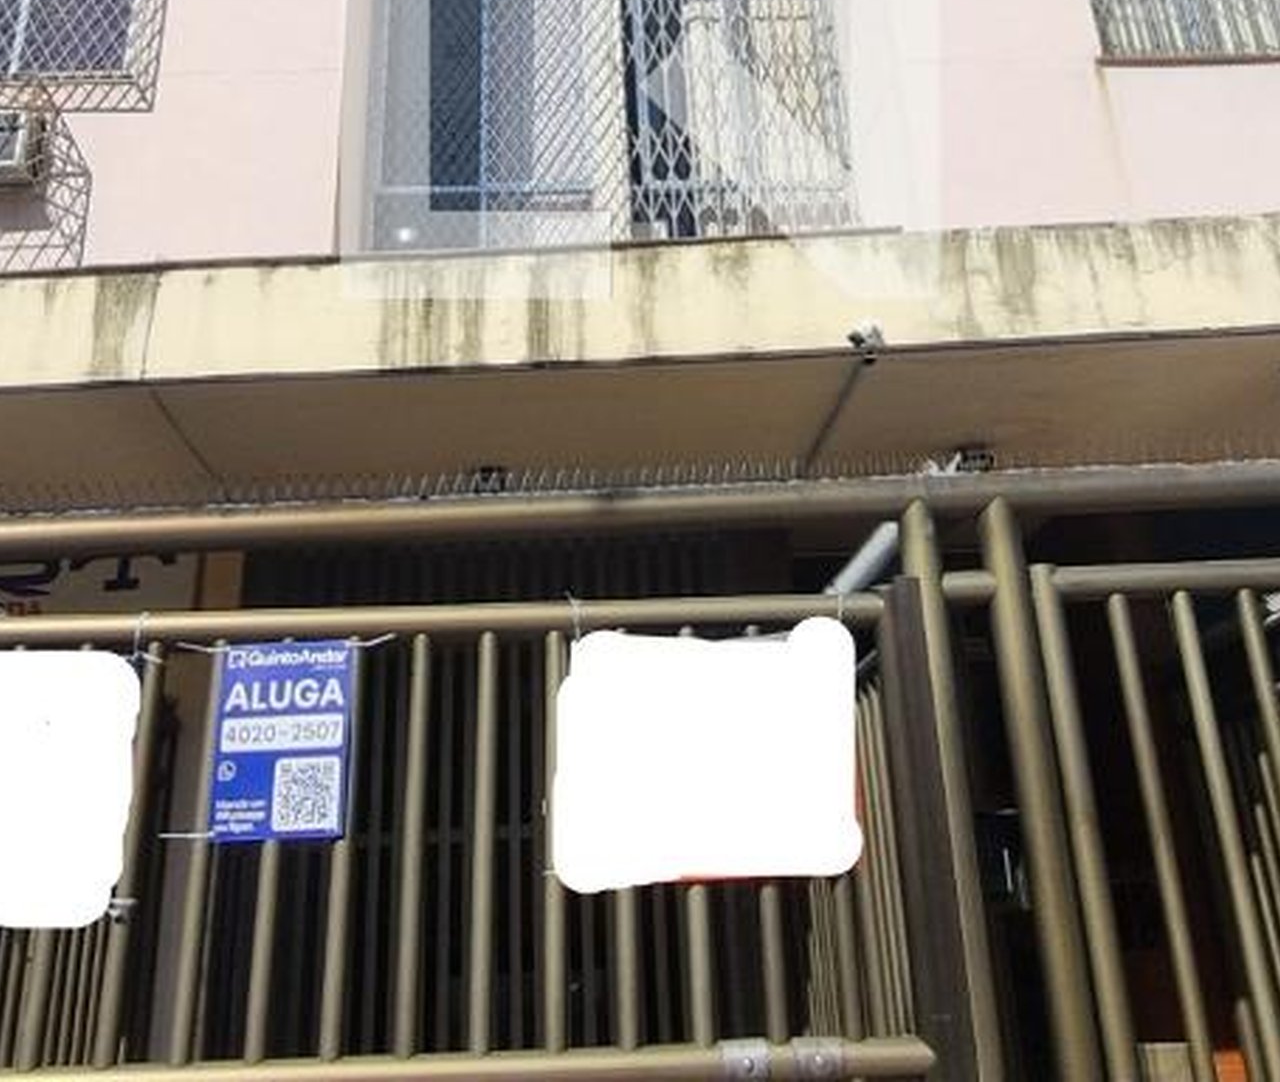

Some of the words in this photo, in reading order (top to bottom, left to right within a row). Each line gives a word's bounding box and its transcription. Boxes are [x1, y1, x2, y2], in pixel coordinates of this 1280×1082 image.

[248, 648, 349, 667] QuintoAndar
[224, 677, 345, 712] ALUGA
[224, 721, 341, 743] 4020-2507
